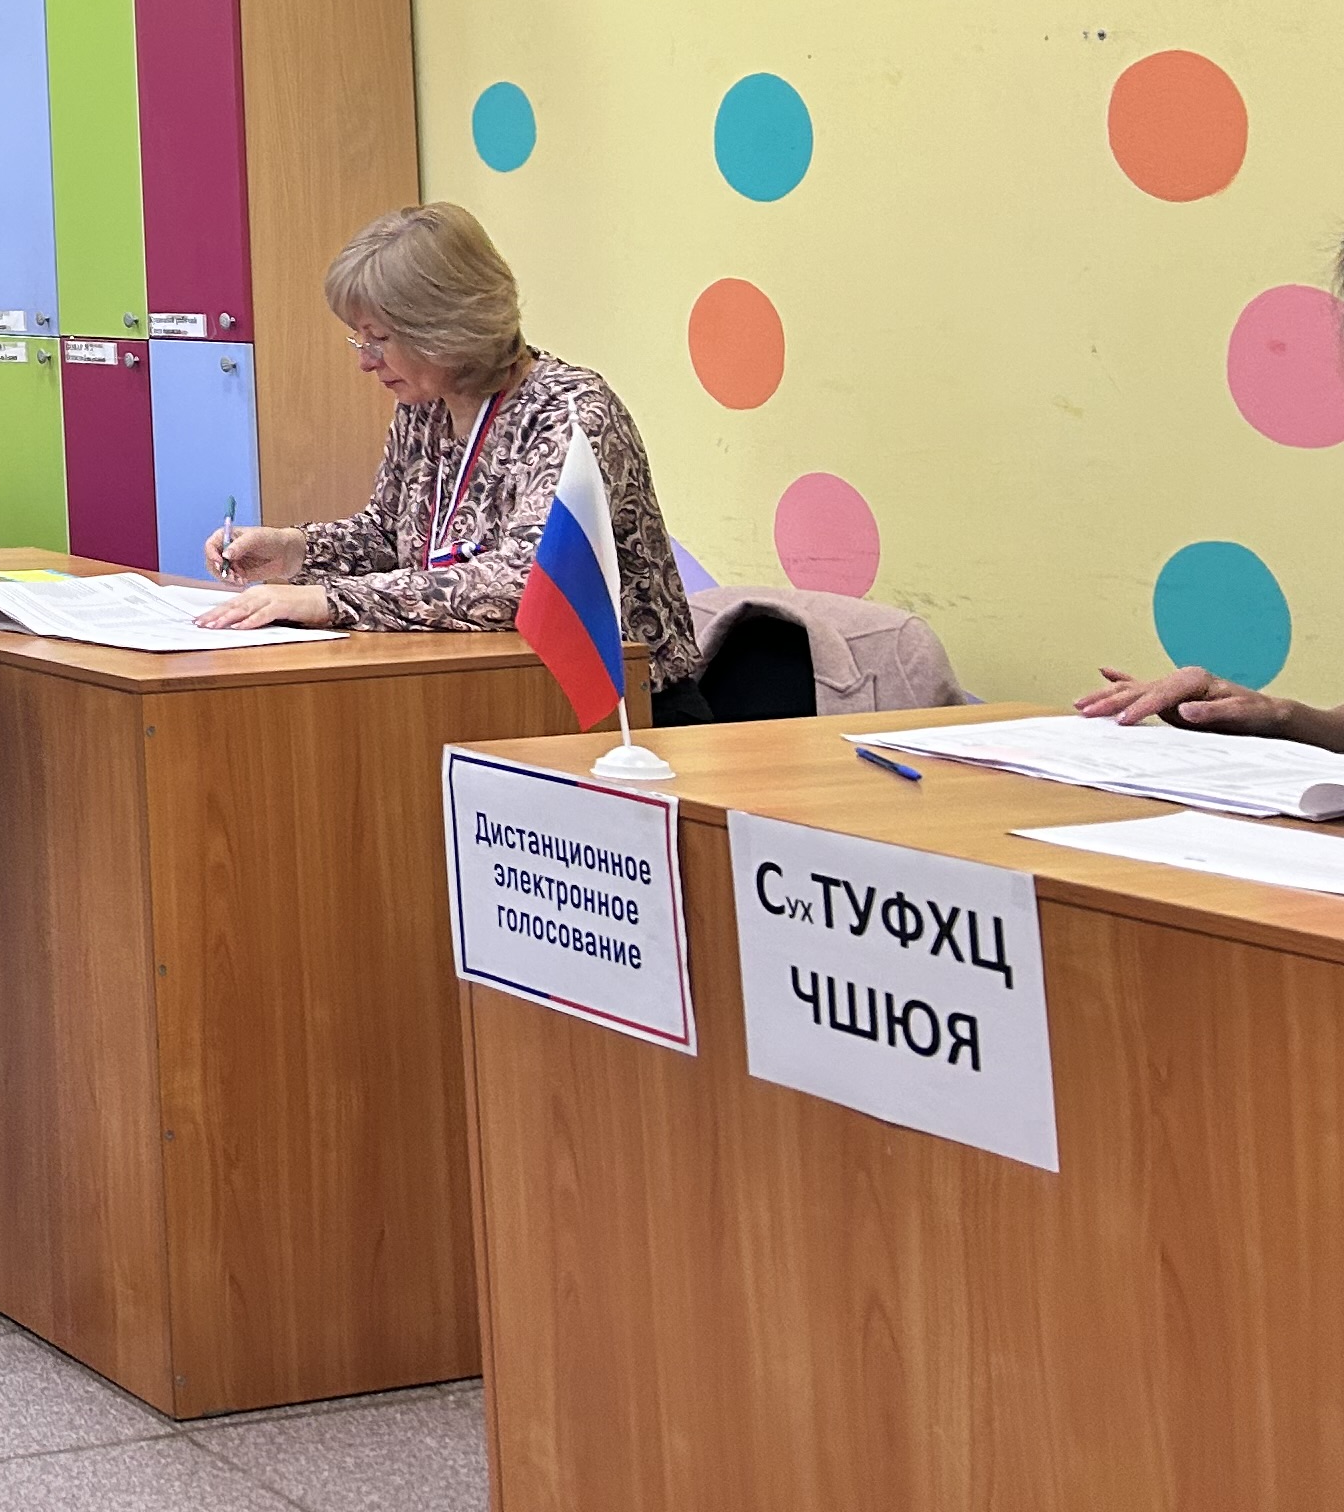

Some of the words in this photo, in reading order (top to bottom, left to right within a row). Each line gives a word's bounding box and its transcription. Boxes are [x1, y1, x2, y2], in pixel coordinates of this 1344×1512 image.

[205, 702, 254, 715] КИМГЗ
[475, 811, 653, 886] Дистанционное
[494, 862, 640, 926] электронное
[755, 861, 1014, 990] СухТУФХЦ
[497, 903, 643, 970] голосование
[789, 964, 982, 1072] ЧШЮЯ
